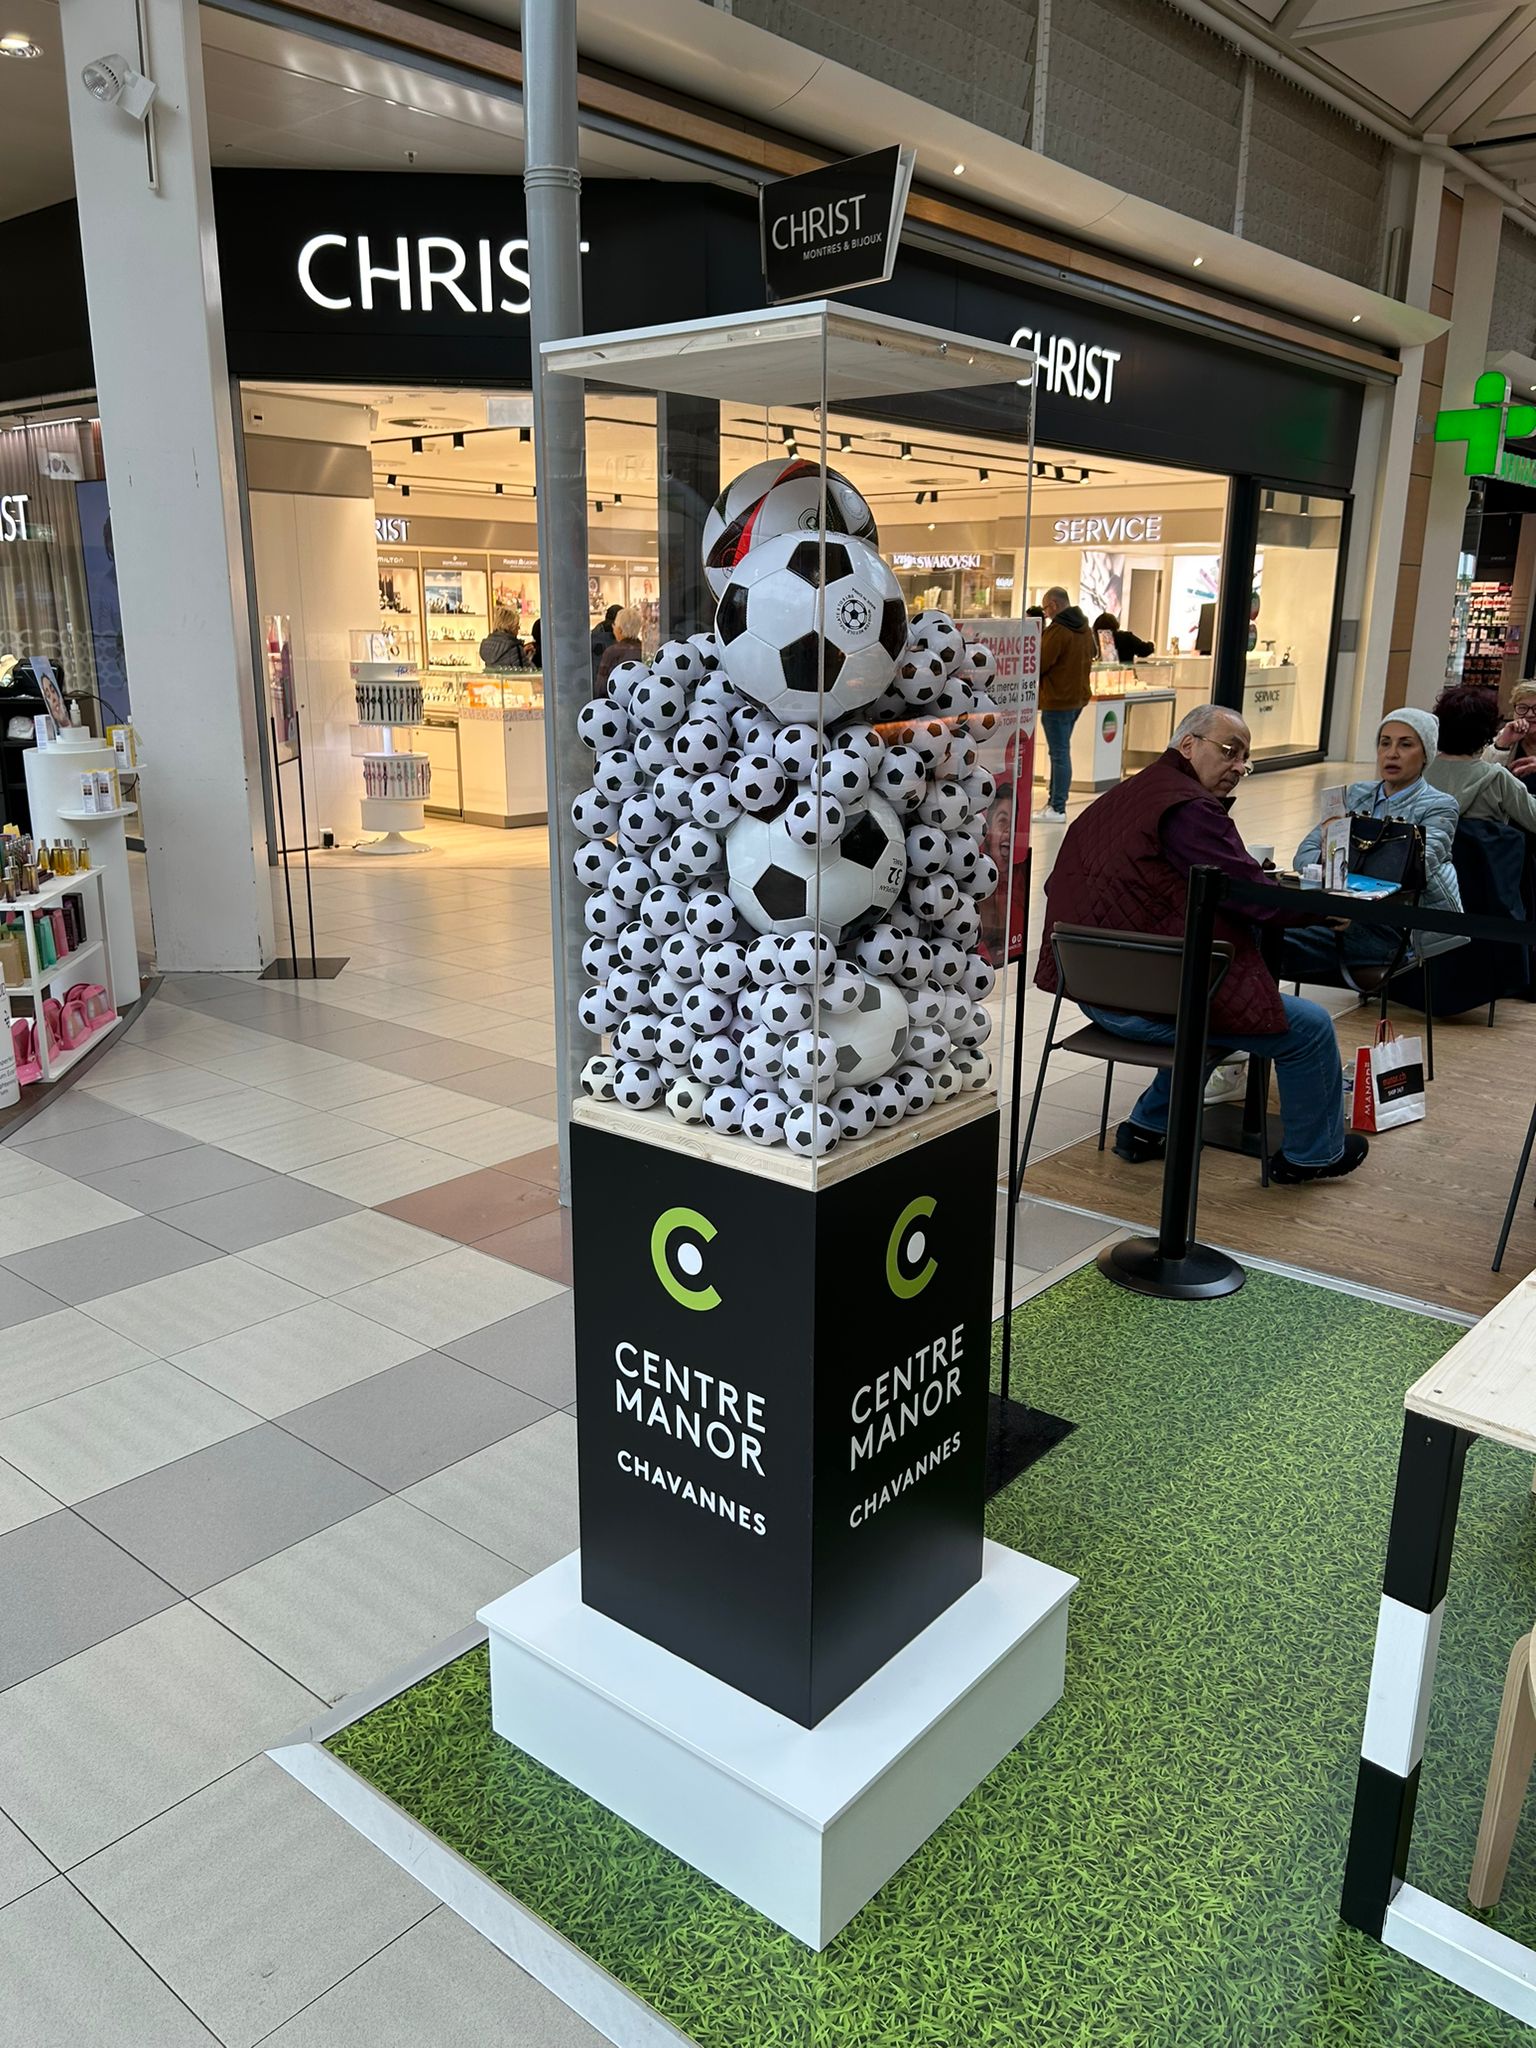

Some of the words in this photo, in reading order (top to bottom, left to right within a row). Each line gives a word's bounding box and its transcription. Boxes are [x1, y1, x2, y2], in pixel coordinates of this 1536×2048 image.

[772, 194, 866, 250] CHRIST
[803, 242, 842, 261] MONTRES
[843, 240, 851, 251] &
[851, 232, 883, 249] BIJOUX
[298, 234, 589, 314] CHRIS
[916, 554, 980, 569] SWAROVSKI
[1053, 516, 1162, 543] SERVICE
[972, 632, 1036, 656] HANES
[996, 655, 1036, 676] NETES
[888, 867, 902, 885] 32
[614, 1341, 766, 1434] CENTRE
[851, 1323, 965, 1425] CENTRE
[615, 1378, 766, 1477] MANOR
[849, 1366, 962, 1472] MANOR
[616, 1449, 767, 1537] CHAVANNES
[848, 1432, 962, 1529] CHAVANNES
